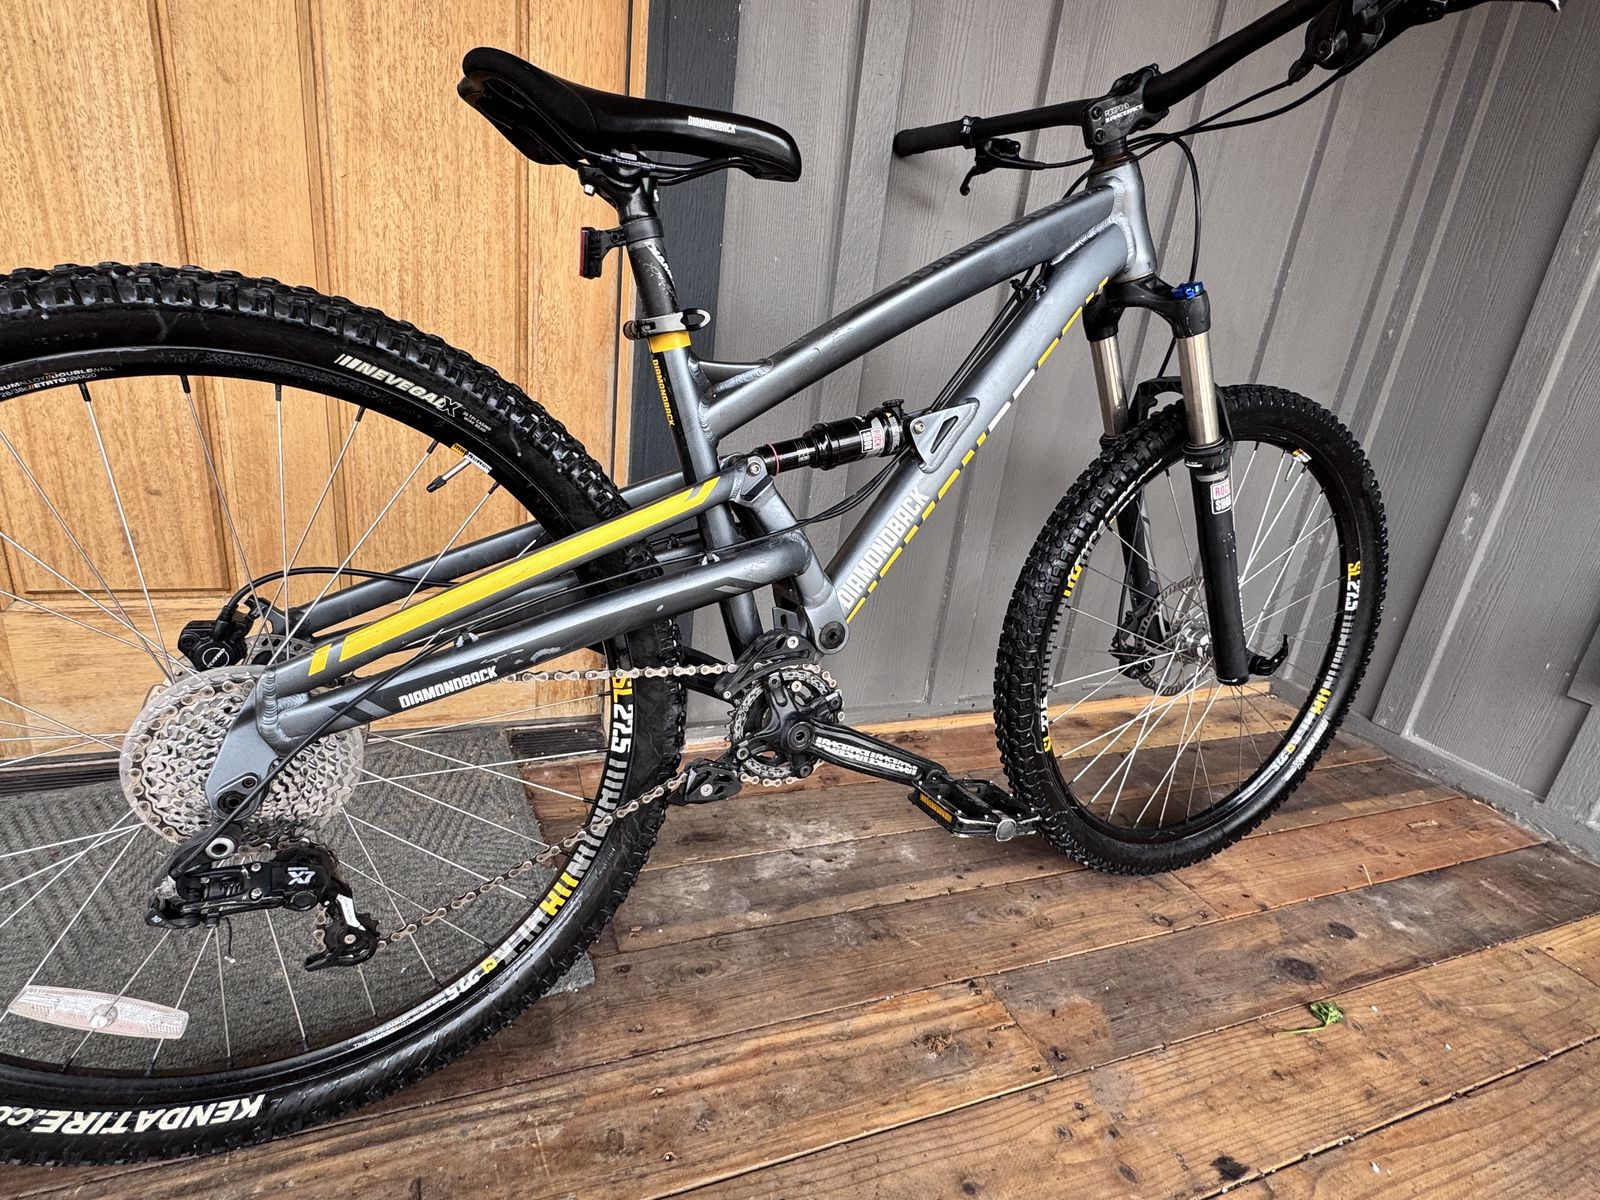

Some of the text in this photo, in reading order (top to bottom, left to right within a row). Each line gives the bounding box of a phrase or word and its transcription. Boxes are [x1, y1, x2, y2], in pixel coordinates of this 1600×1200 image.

[687, 115, 737, 134] DIAMONDBACK
[652, 359, 675, 427] DIAMONDBACK
[837, 486, 930, 610] DIAMONDBACK
[1347, 560, 1361, 582] SL
[398, 665, 498, 709] DIAMONDBACK
[610, 703, 634, 754] 27.5
[288, 871, 316, 886] X7
